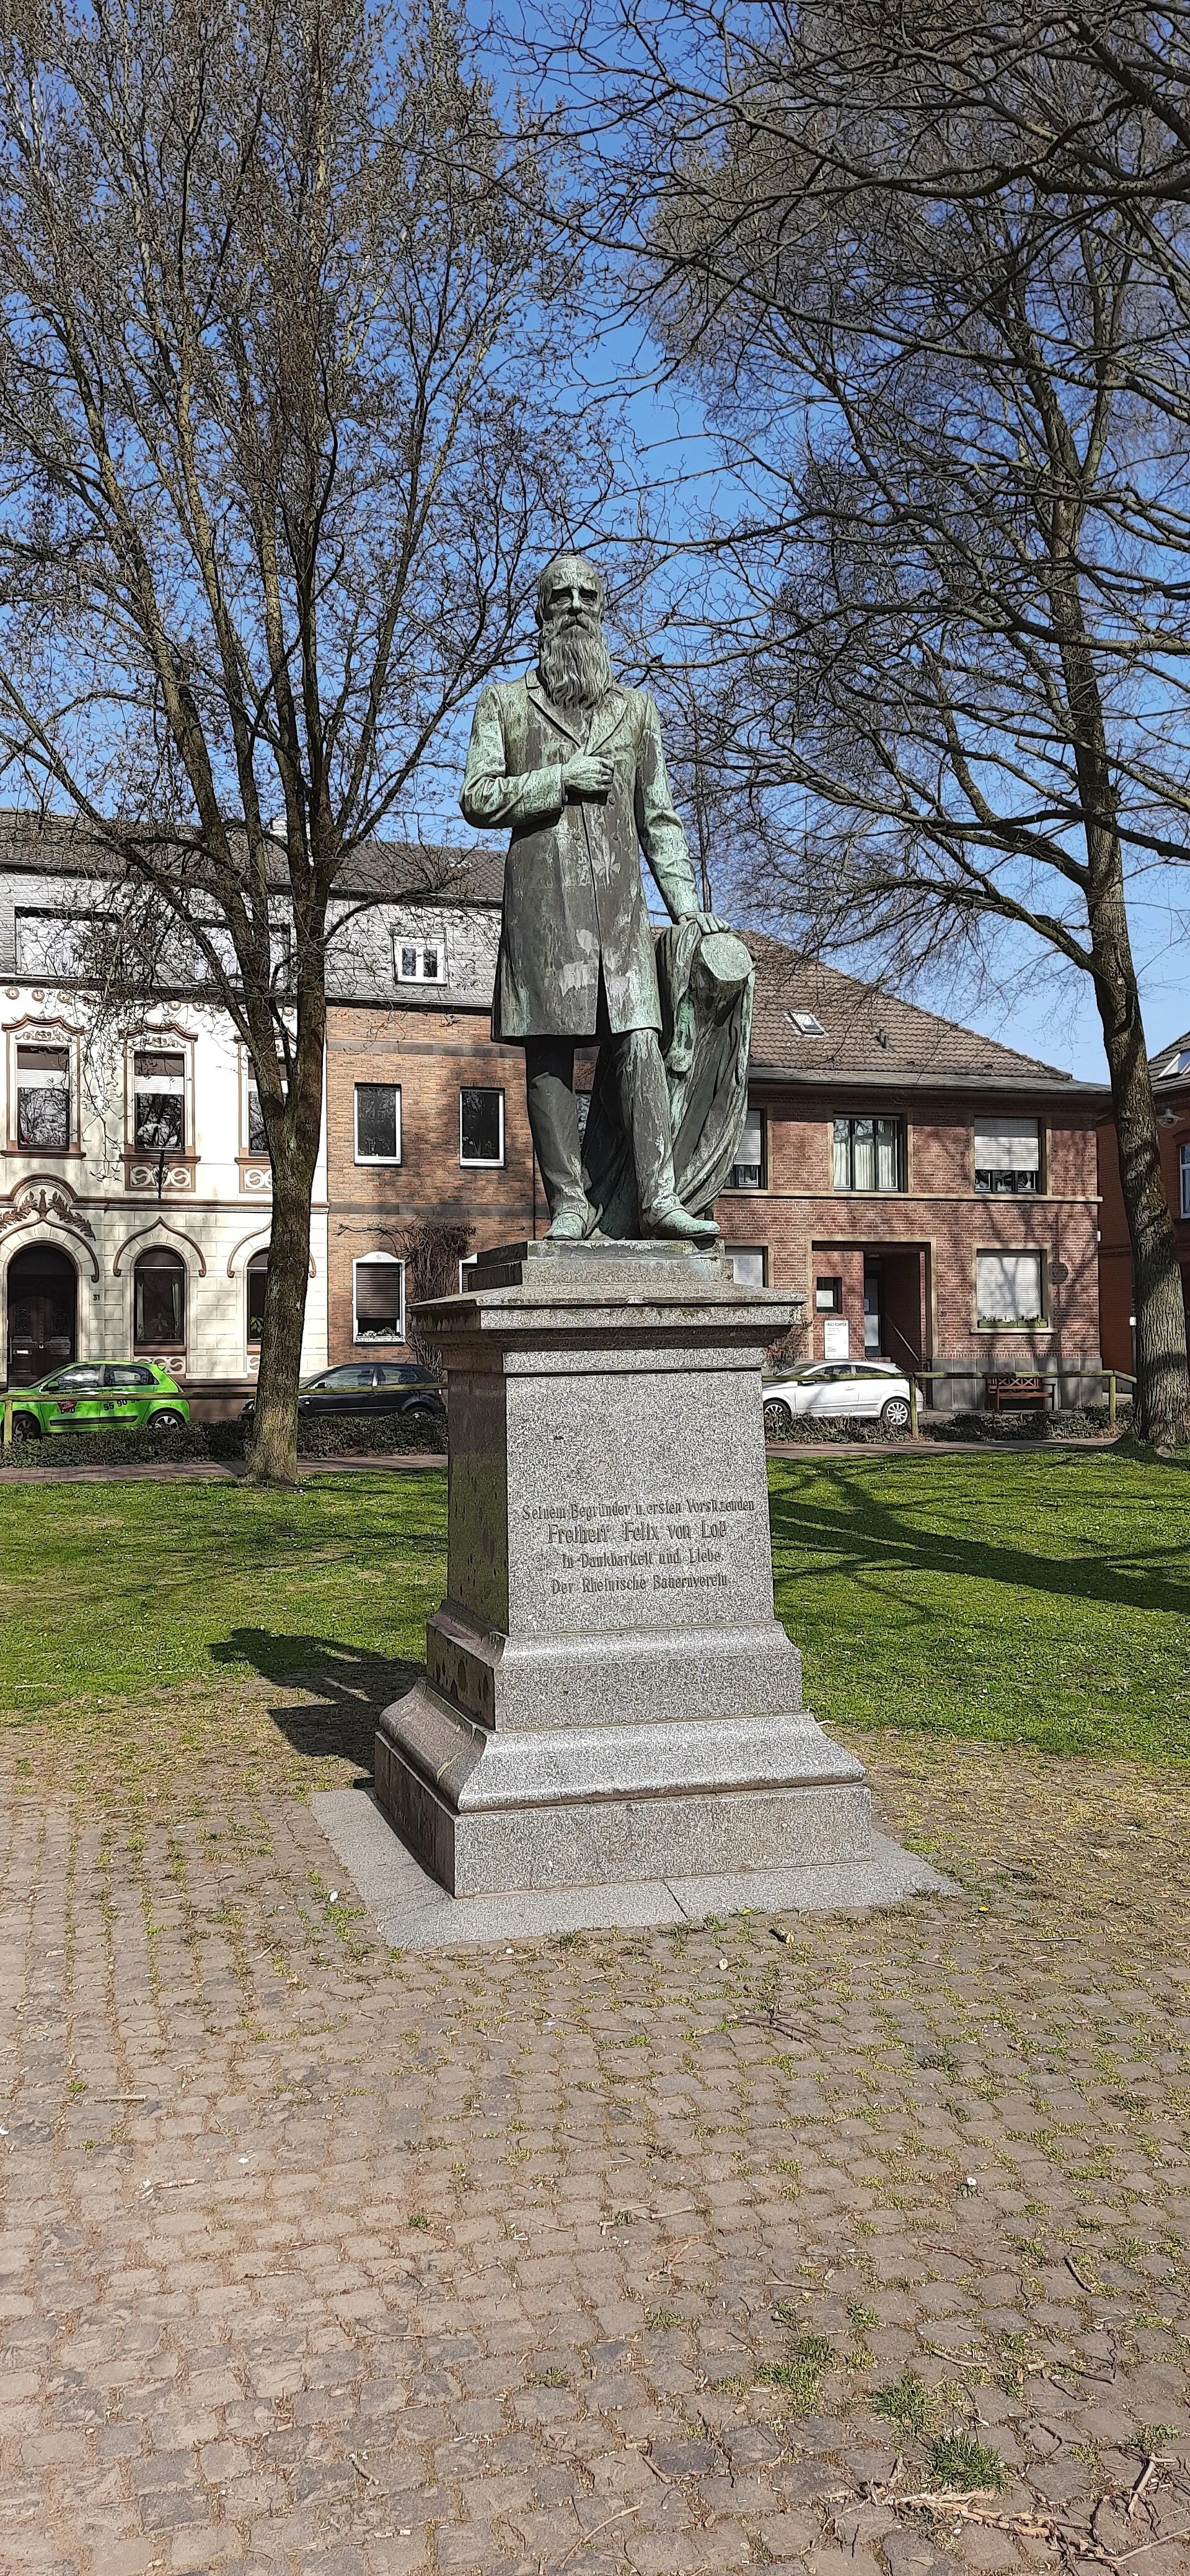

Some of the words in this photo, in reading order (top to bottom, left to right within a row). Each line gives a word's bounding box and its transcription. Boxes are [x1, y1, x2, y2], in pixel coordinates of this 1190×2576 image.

[646, 1500, 682, 1514] ersten
[624, 1520, 659, 1541] Felix
[668, 1525, 691, 1539] von
[701, 1519, 727, 1538] Loë
[581, 1550, 653, 1568] Dankbarkeit
[659, 1549, 682, 1564] und
[552, 1580, 574, 1594] Der
[582, 1576, 646, 1592] Rheinische
